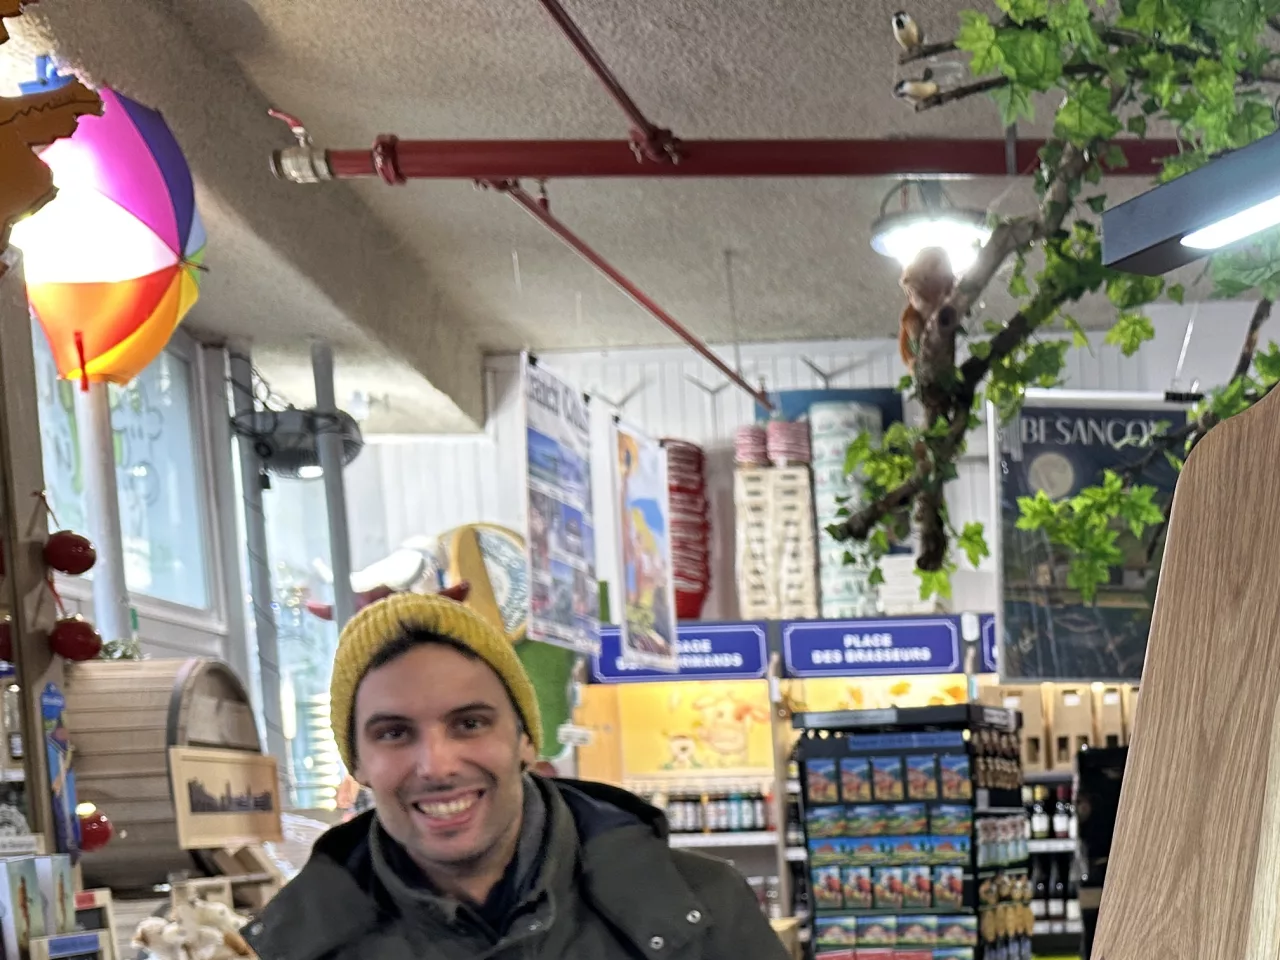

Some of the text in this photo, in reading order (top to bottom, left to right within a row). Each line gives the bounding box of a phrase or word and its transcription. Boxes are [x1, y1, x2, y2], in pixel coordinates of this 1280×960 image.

[843, 633, 889, 648] PLACE
[679, 652, 743, 669] RMANDS
[811, 649, 842, 664] DES
